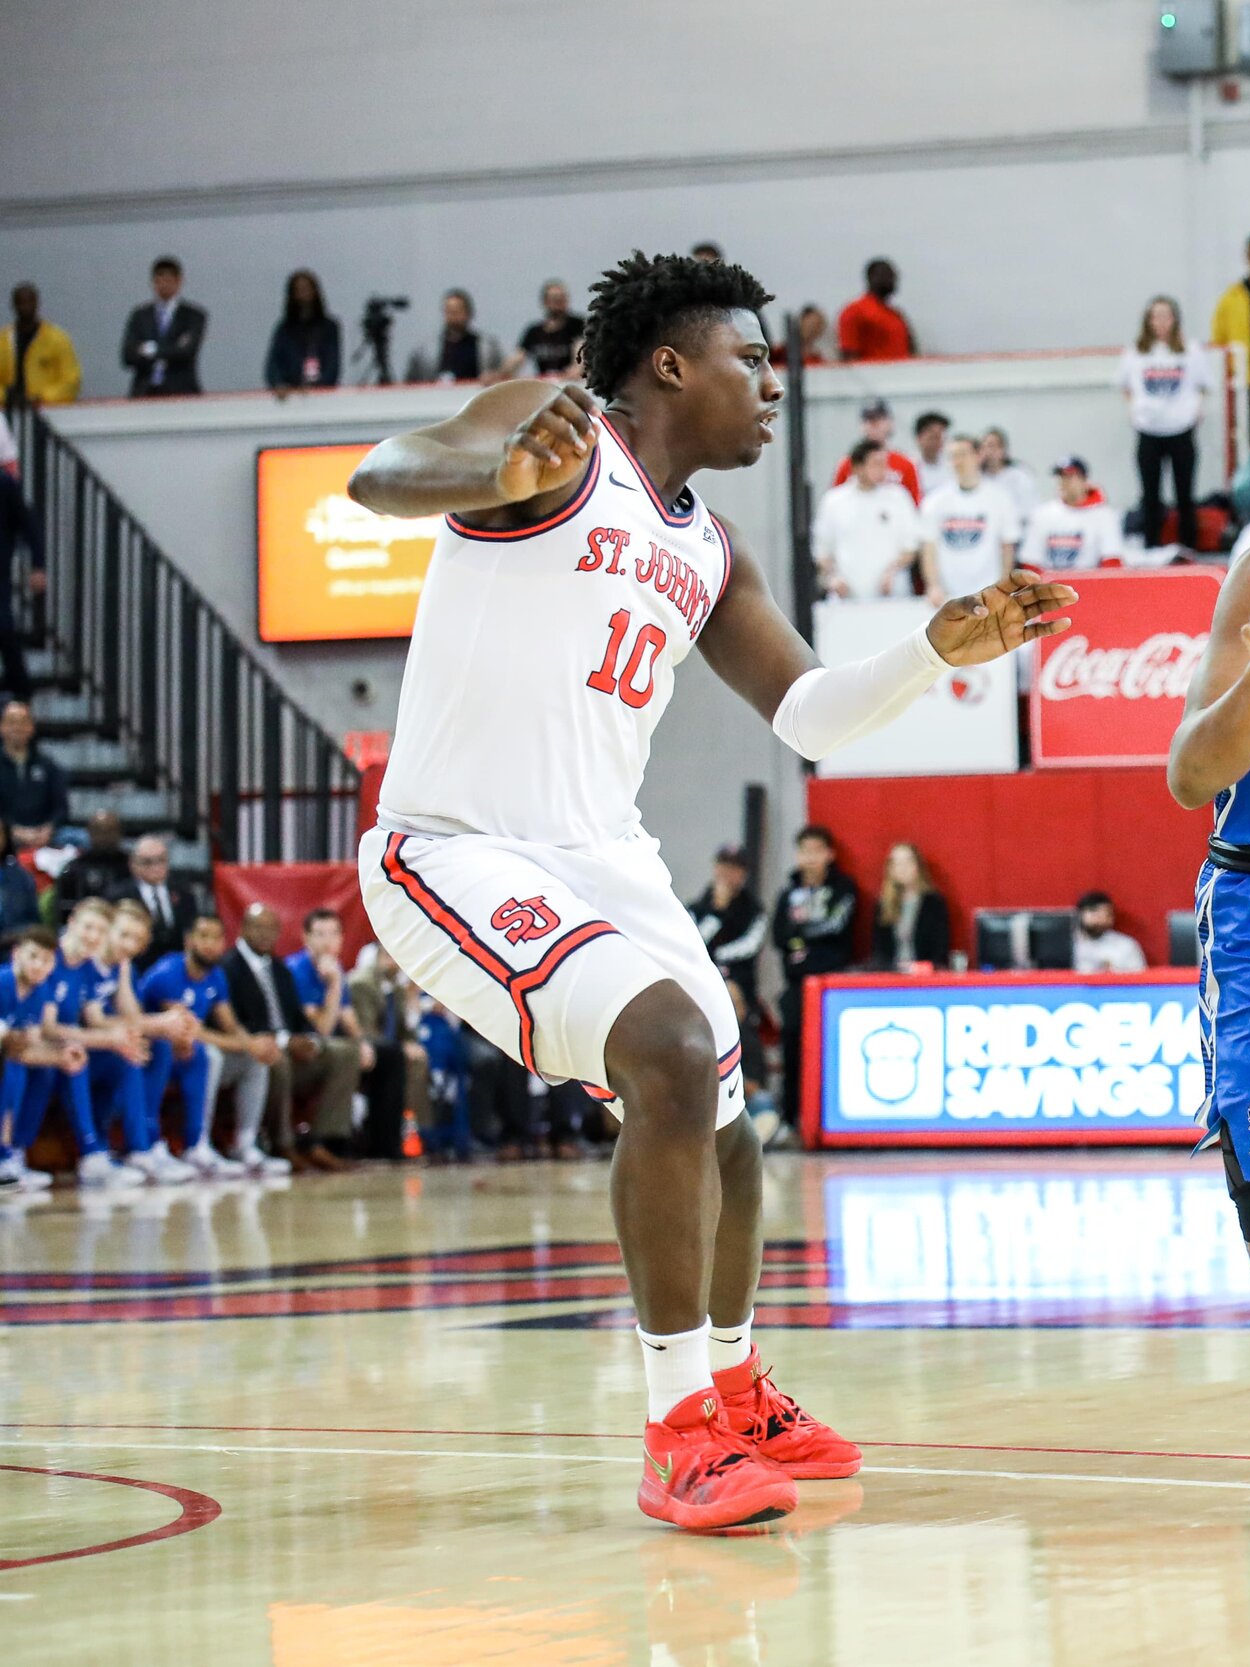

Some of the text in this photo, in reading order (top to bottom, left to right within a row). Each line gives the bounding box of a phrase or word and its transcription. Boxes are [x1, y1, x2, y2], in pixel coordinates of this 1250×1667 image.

[574, 527, 630, 576] ST.
[586, 608, 666, 709] 10
[944, 1062, 1174, 1119] SAVINGS
